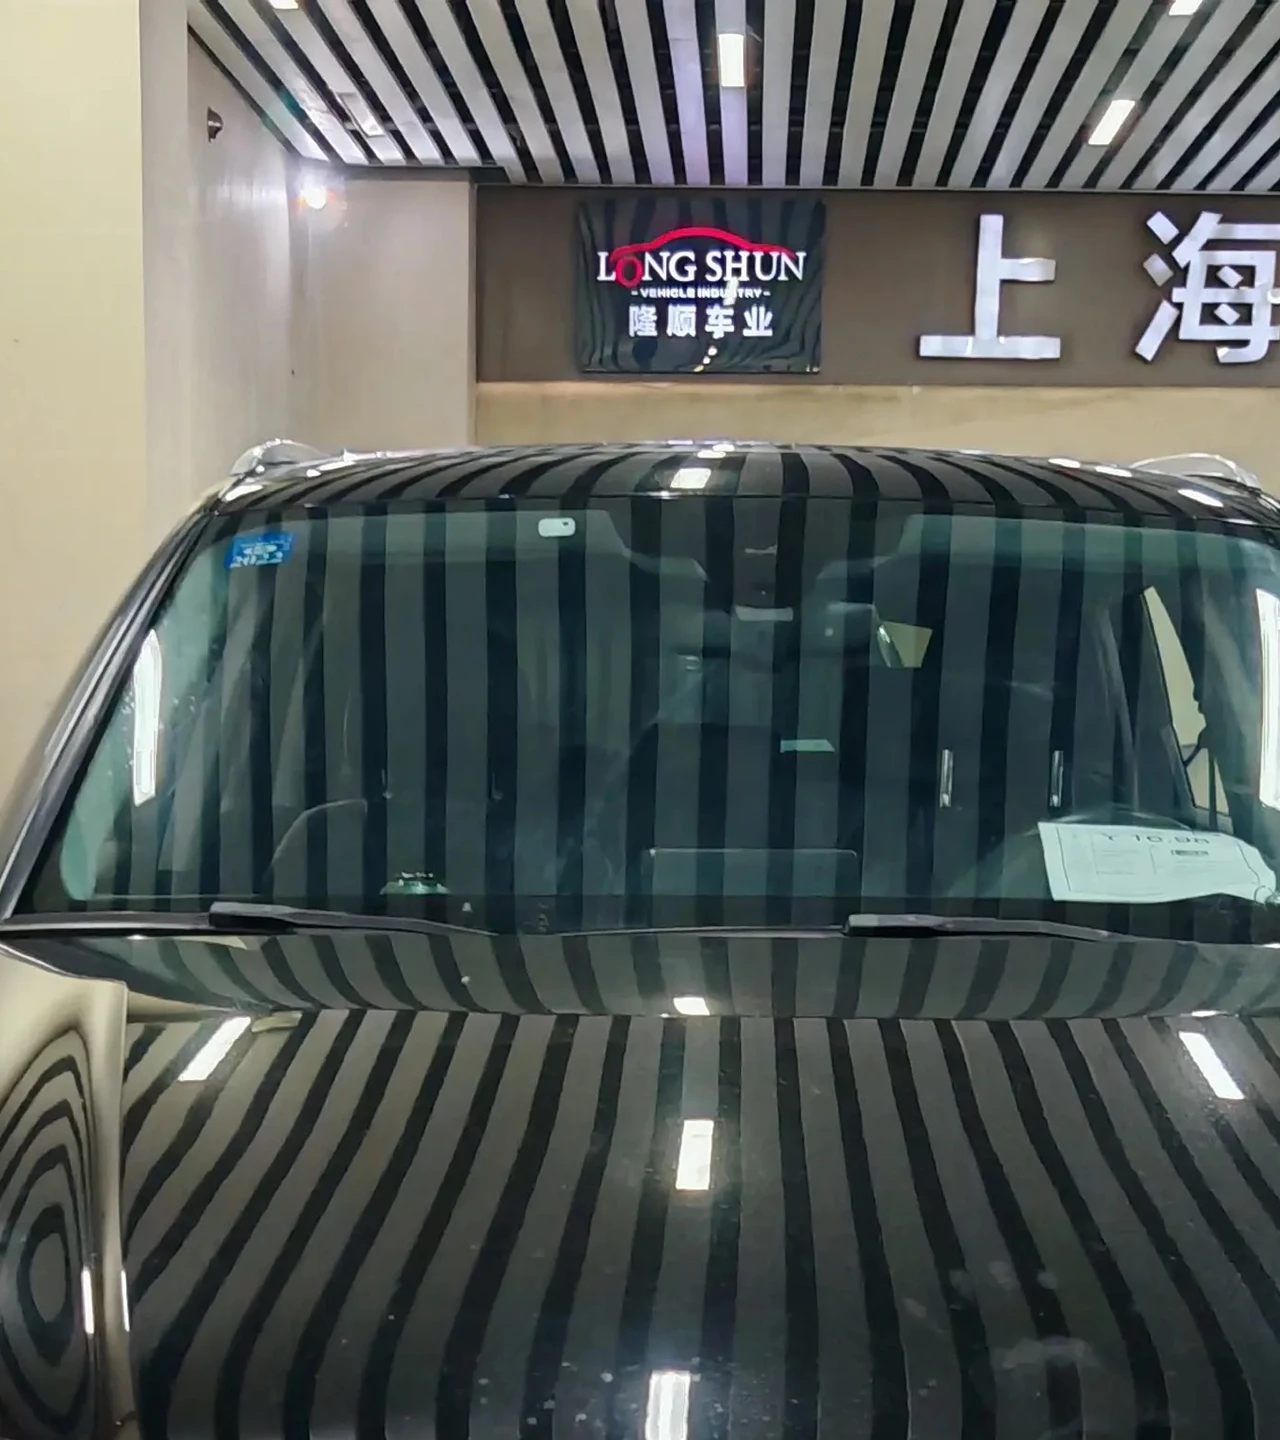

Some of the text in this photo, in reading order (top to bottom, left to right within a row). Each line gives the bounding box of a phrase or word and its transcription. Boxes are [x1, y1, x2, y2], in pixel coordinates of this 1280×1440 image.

[597, 250, 807, 289] LONG SHUN
[697, 287, 762, 299] INDUTRY
[629, 304, 773, 339] 隆顺车业
